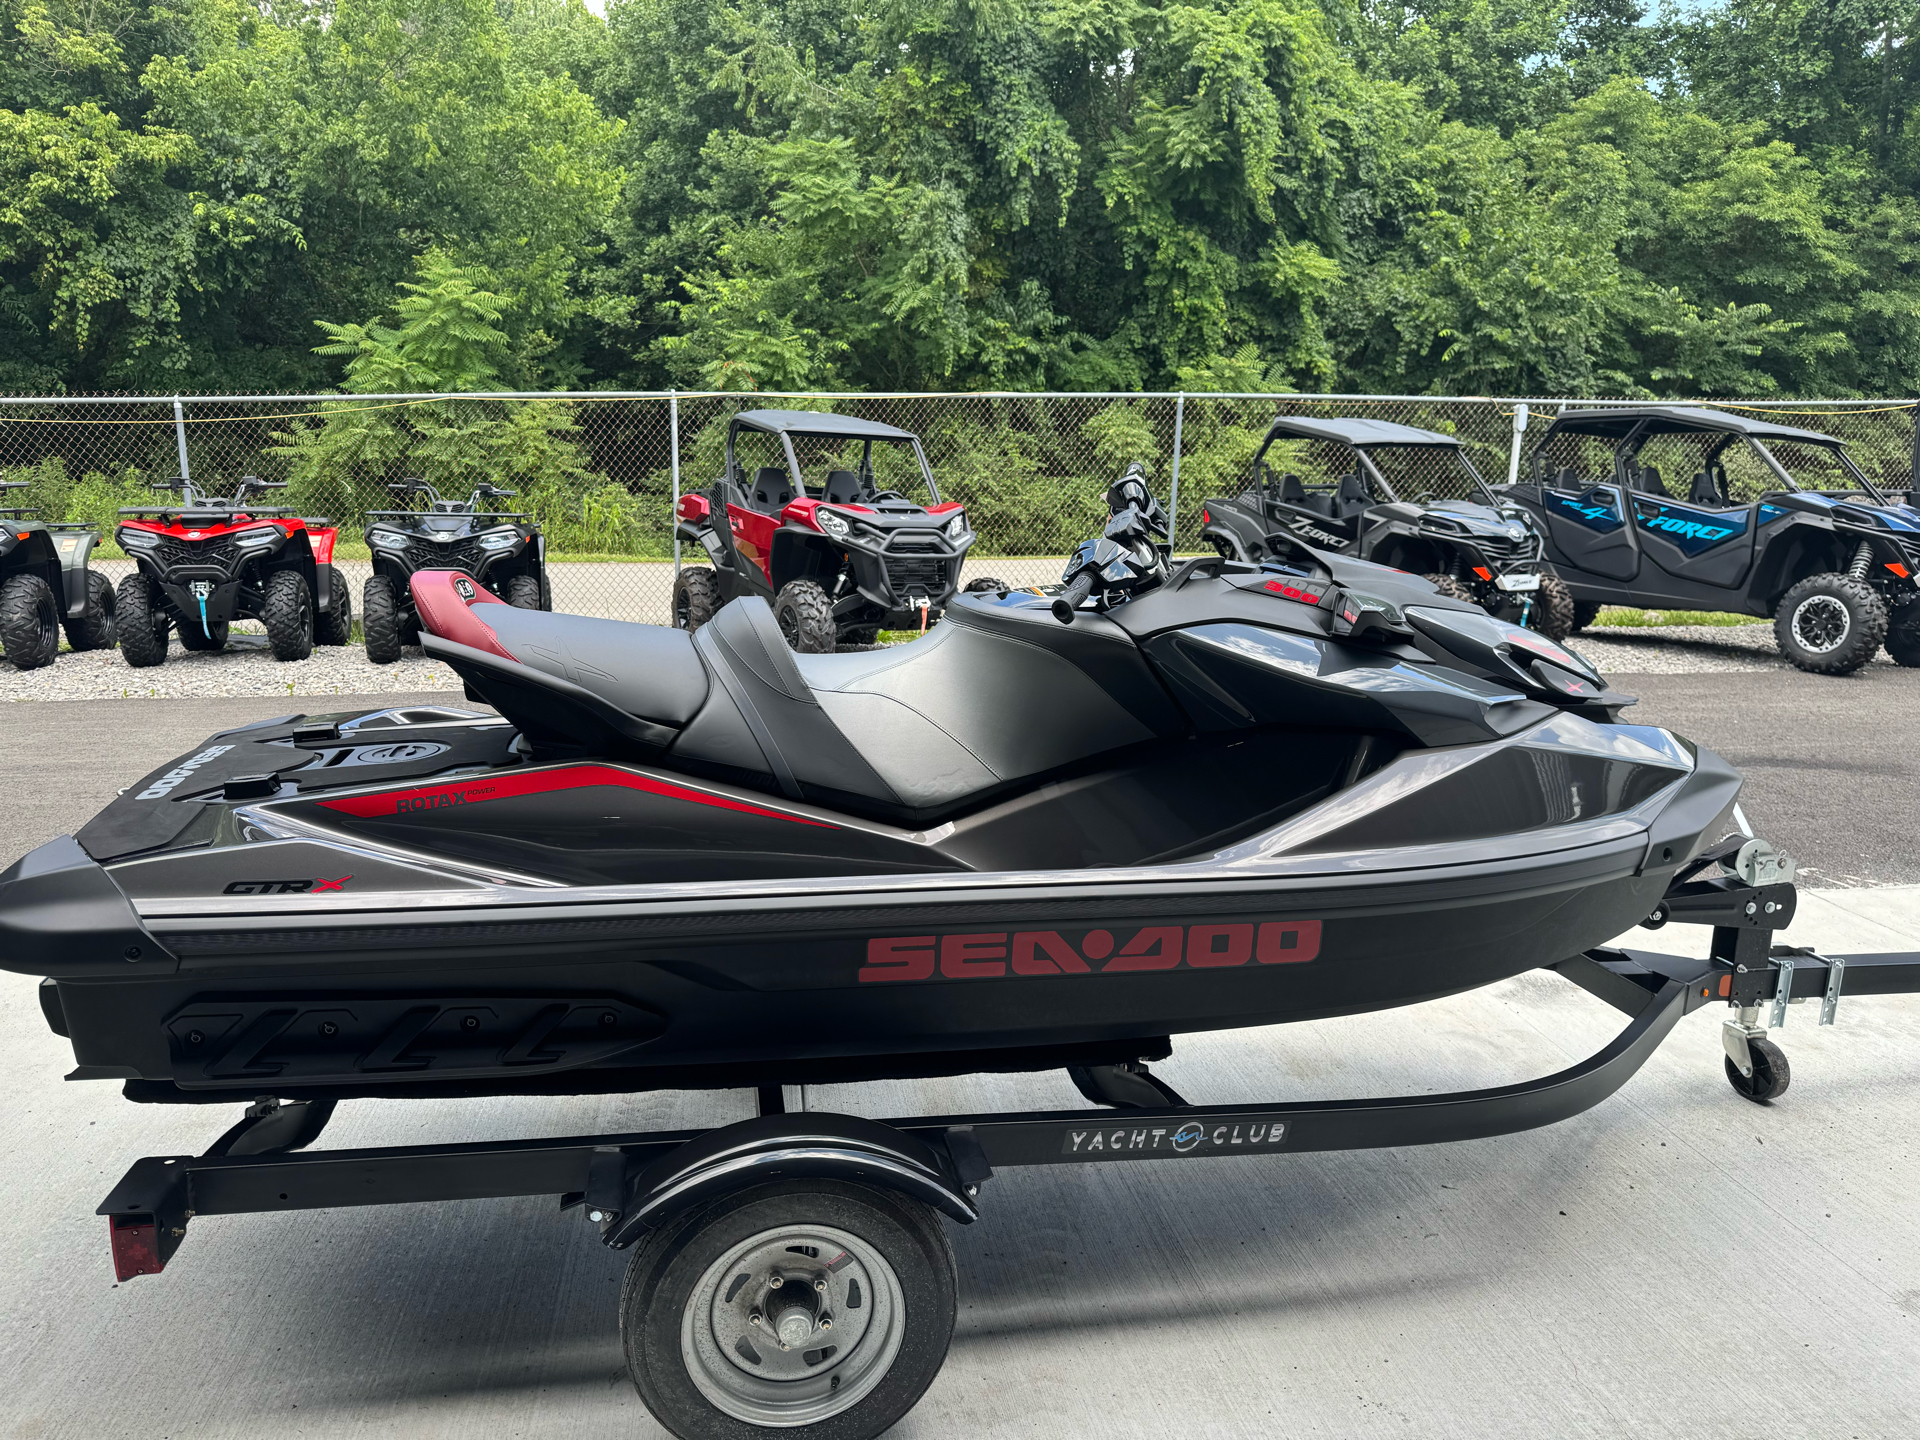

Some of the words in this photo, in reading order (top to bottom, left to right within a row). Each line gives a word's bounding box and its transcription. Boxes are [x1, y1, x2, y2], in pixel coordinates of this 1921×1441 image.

[1264, 580, 1320, 604] 300
[396, 791, 468, 814] ROTAX
[467, 786, 496, 797] POWER
[1071, 1128, 1167, 1152] YACHT
[1212, 1123, 1285, 1145] CLUB
